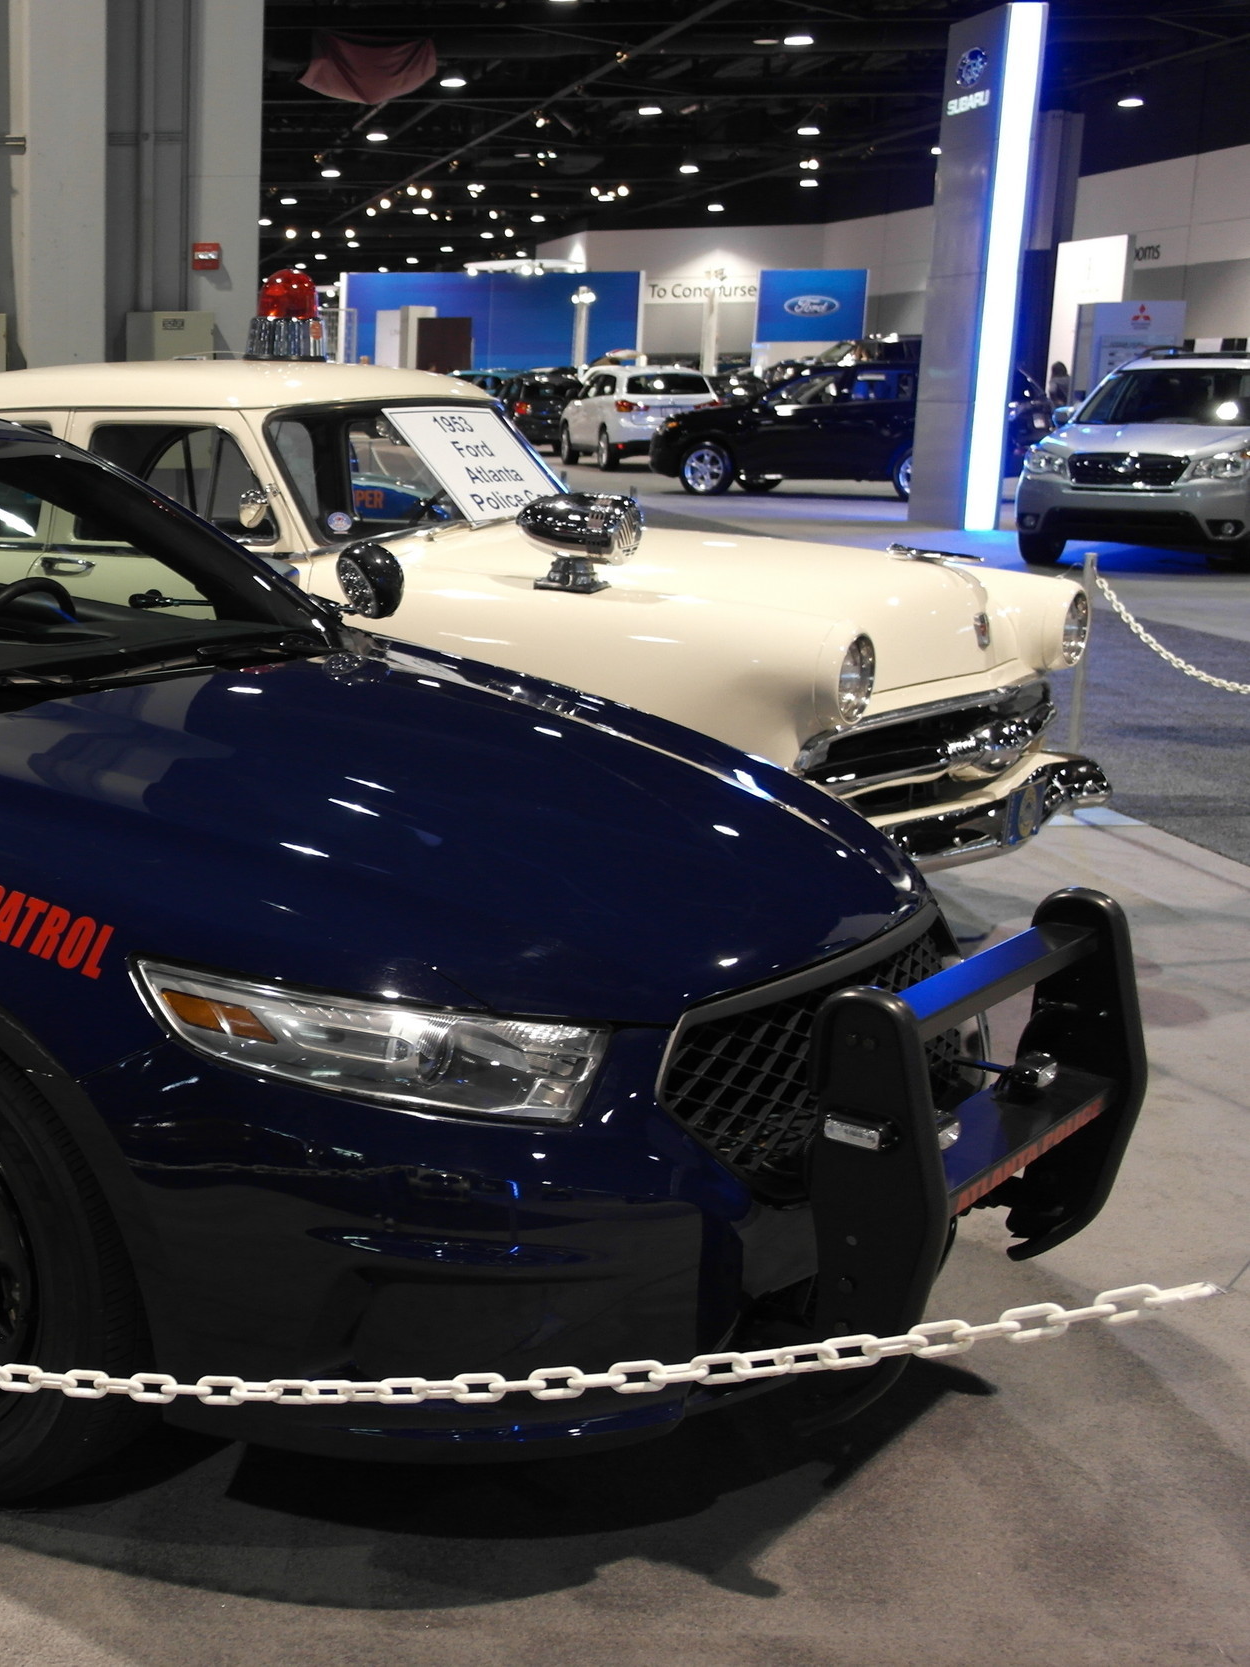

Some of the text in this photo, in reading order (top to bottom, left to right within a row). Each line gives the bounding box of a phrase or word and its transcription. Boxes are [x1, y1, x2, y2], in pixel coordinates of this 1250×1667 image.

[947, 89, 990, 116] SUBARU
[650, 284, 667, 299] To
[793, 298, 829, 314] Ford
[432, 416, 475, 433] 1953
[451, 440, 496, 459] Ford
[464, 465, 524, 485] Atlanta
[469, 489, 527, 513] Police
